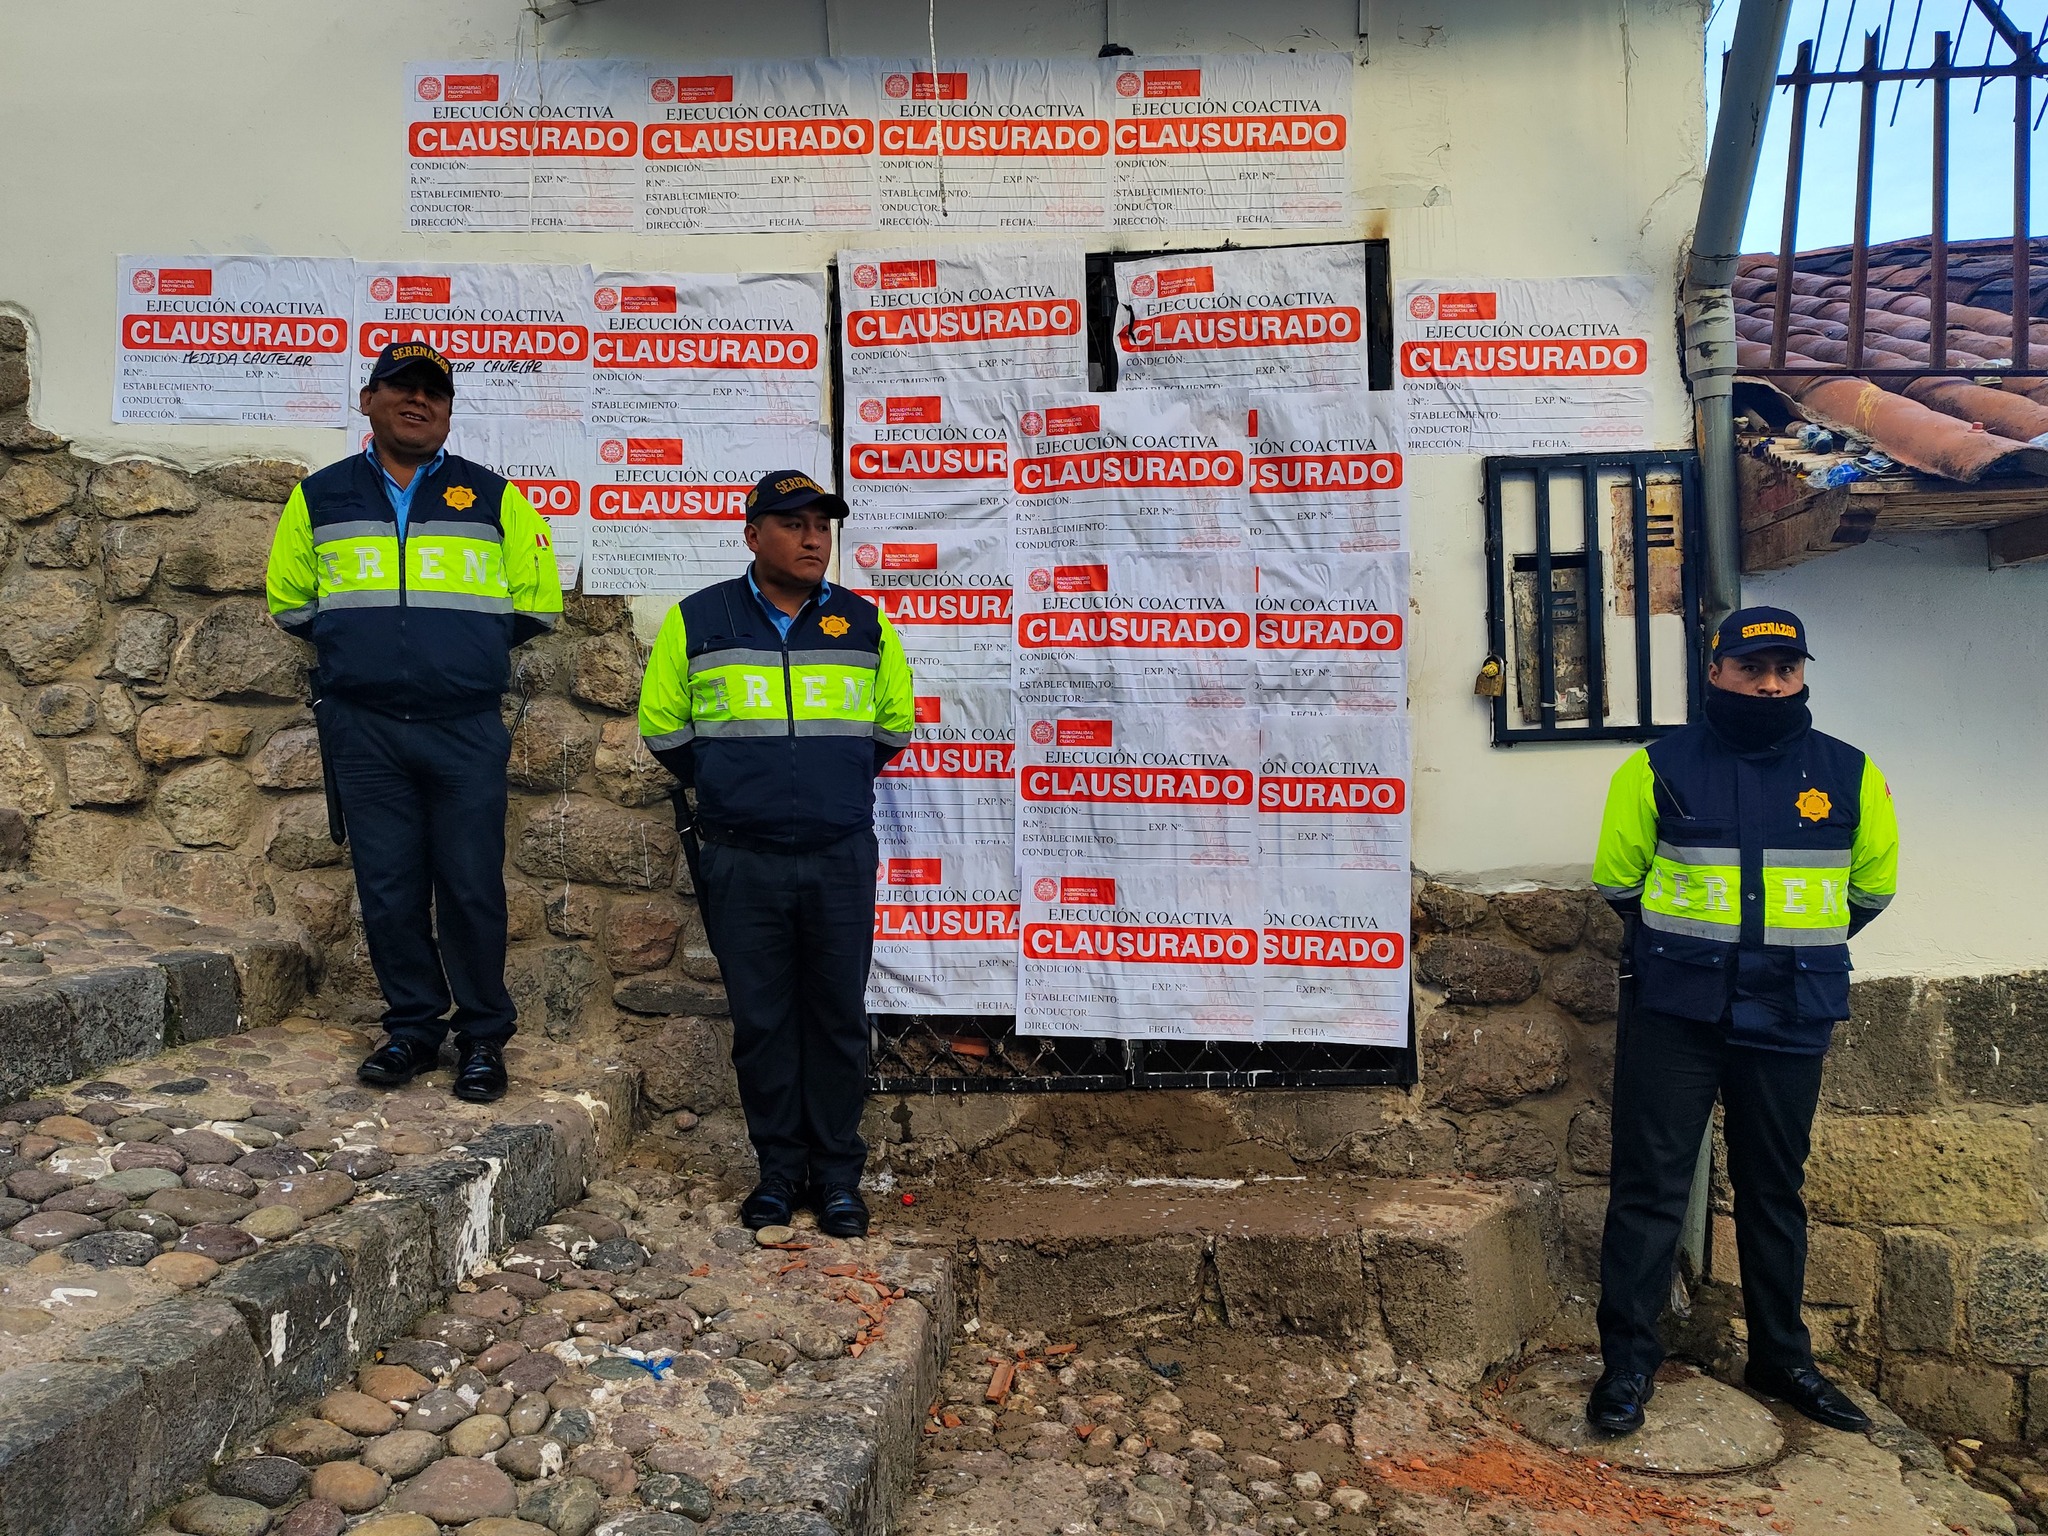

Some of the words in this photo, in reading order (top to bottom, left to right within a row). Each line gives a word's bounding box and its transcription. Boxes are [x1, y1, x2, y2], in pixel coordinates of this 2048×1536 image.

[433, 103, 524, 119] EJECUCIÓN
[529, 105, 614, 119] COACTIVA
[666, 103, 758, 121] EJECUCIÓN
[763, 104, 848, 119] COACTIVA
[900, 102, 993, 117] EJECUCIÓN
[998, 105, 1084, 117] COACTIVA
[1132, 98, 1226, 116] EJECUCIÓN
[1232, 100, 1321, 114] COACTIVA
[417, 127, 629, 152] CLAUSURADO
[651, 125, 865, 154] CLAUSURADO
[883, 126, 1100, 150] CLAUSURADO
[1116, 121, 1338, 149] CLAUSURADO
[411, 161, 469, 171] CONDICIÓN:
[645, 164, 703, 173] CONDICIÓN:
[771, 176, 792, 184] EXP.
[411, 190, 502, 199] ESTABLECIMIENTO:
[646, 192, 740, 201] ESTABLECIMIENTO:
[411, 204, 474, 213] CONDUCTOR:
[646, 207, 710, 215] CONDUCTOR:
[411, 217, 467, 227] DIRECCIÓN:
[531, 218, 566, 226] FECHA:
[646, 219, 703, 230] DIRECCIÓN:
[1237, 215, 1272, 224] FECHA:
[870, 289, 964, 307] EJECUCIÓN
[969, 286, 1055, 302] COACTIVA
[146, 298, 235, 313] EJECUCIÓN
[240, 302, 324, 314] COACTIVA
[1147, 293, 1242, 317] EJECUCIÓN
[1247, 293, 1335, 307] COACTIVA
[385, 307, 475, 321] EJECUCIÓN
[481, 309, 564, 322] COACTIVA
[609, 315, 703, 330] EJECUCIÓN
[708, 318, 794, 331] COACTIVA
[856, 306, 1072, 341] CLAUSURADO
[1132, 313, 1351, 345] CLAUSURADO
[130, 321, 339, 347] CLAUSURADO
[1426, 322, 1523, 338] EJECUCIÓN
[1528, 324, 1620, 337] COACTIVA
[594, 339, 809, 364] CLAUSURADO
[851, 349, 910, 360] CONDICIÓN:
[124, 354, 180, 363] CONDICIÓN:
[183, 351, 238, 366] MEDIDA
[243, 353, 312, 367] CAUTELAR
[978, 360, 998, 368] EXP.
[1127, 355, 1186, 366] CONDICIÓN:
[1409, 345, 1637, 372] CLAUSURADO
[484, 361, 542, 373] CAUTELAR
[1256, 366, 1276, 375] EXP.
[246, 370, 265, 378] EXP.
[123, 383, 214, 392] ESTABLECIMIENTO:
[713, 388, 733, 396] EXP.
[1403, 382, 1464, 391] CONDICIÓN:
[122, 397, 183, 405] CONDUCTOR:
[122, 409, 177, 418] DIRECCIÓN:
[242, 413, 276, 421] FECHA:
[875, 425, 968, 441] EJECUCIÓN
[1036, 433, 1127, 455] EJECUCIÓN
[1133, 436, 1218, 449] COACTIVA
[1290, 439, 1377, 453] COACTIVA
[858, 450, 1007, 473] CLAUSUR
[615, 468, 707, 483] EJECUCIÓN
[1021, 457, 1234, 488] CLAUSURADO
[852, 483, 912, 492] CONDICIÓN:
[599, 491, 747, 514] CLAUSUR
[1015, 496, 1071, 507] CONDICIÓN:
[852, 512, 947, 520] ESTABLECIMIENTO:
[1139, 508, 1160, 516] EXP.
[1297, 512, 1316, 520] EXP.
[592, 524, 651, 533] CONDICIÓN:
[1015, 523, 1108, 535] ESTABLECIMIENTO:
[1015, 539, 1078, 549] CONDUCTOR:
[592, 554, 688, 562] ESTABLECIMIENTO:
[592, 567, 656, 575] CONDUCTOR:
[871, 571, 963, 586] EJECUCIÓN
[592, 581, 650, 590] DIRECCIÓN:
[859, 595, 1013, 619] LAUSUR
[1043, 594, 1134, 610] EJECUCIÓN
[1139, 597, 1225, 609] COACTIVA
[1290, 599, 1378, 612] COACTIVA
[1026, 618, 1241, 643] CLAUSURADO
[1259, 620, 1394, 644] SURADO
[1742, 622, 1797, 639] SERENAZGO
[1020, 651, 1078, 661] CONDICIÓN:
[1144, 667, 1165, 675] EXP.
[1019, 680, 1114, 689] ESTABLECIMIENTO:
[1019, 695, 1084, 703] CONDUCTOR:
[1045, 749, 1137, 764] EJECUCIÓN
[1143, 753, 1229, 766] COACTIVA
[1292, 762, 1379, 775] COACTIVA
[1029, 771, 1244, 799] CLAUSURADO
[1261, 782, 1396, 808] SURADO
[1023, 805, 1081, 815] CONDICIÓN:
[1149, 823, 1168, 831] EXP.
[1022, 835, 1116, 844] ESTABLECIMIENTO:
[1022, 848, 1086, 857] CONDUCTOR:
[877, 887, 967, 902] EJECUCIÓN
[874, 911, 1020, 934] LAUSUR
[1049, 908, 1140, 923] EJECUCIÓN
[1146, 912, 1233, 925] COACTIVA
[1291, 914, 1378, 929] COACTIVA
[1031, 930, 1249, 959] CLAUSURADO
[1264, 934, 1395, 962] SURADO
[1025, 964, 1085, 973] CONDICIÓN:
[1152, 983, 1172, 991] EXP.
[1296, 985, 1316, 993] EXP.
[1024, 993, 1119, 1004] ESTABLECIMIENTO:
[1024, 1008, 1090, 1017] CONDUCTOR:
[1024, 1021, 1083, 1031] DIRECCIÓN:
[1149, 1026, 1184, 1034] FECHA:
[1292, 1028, 1328, 1036] FECHA:
